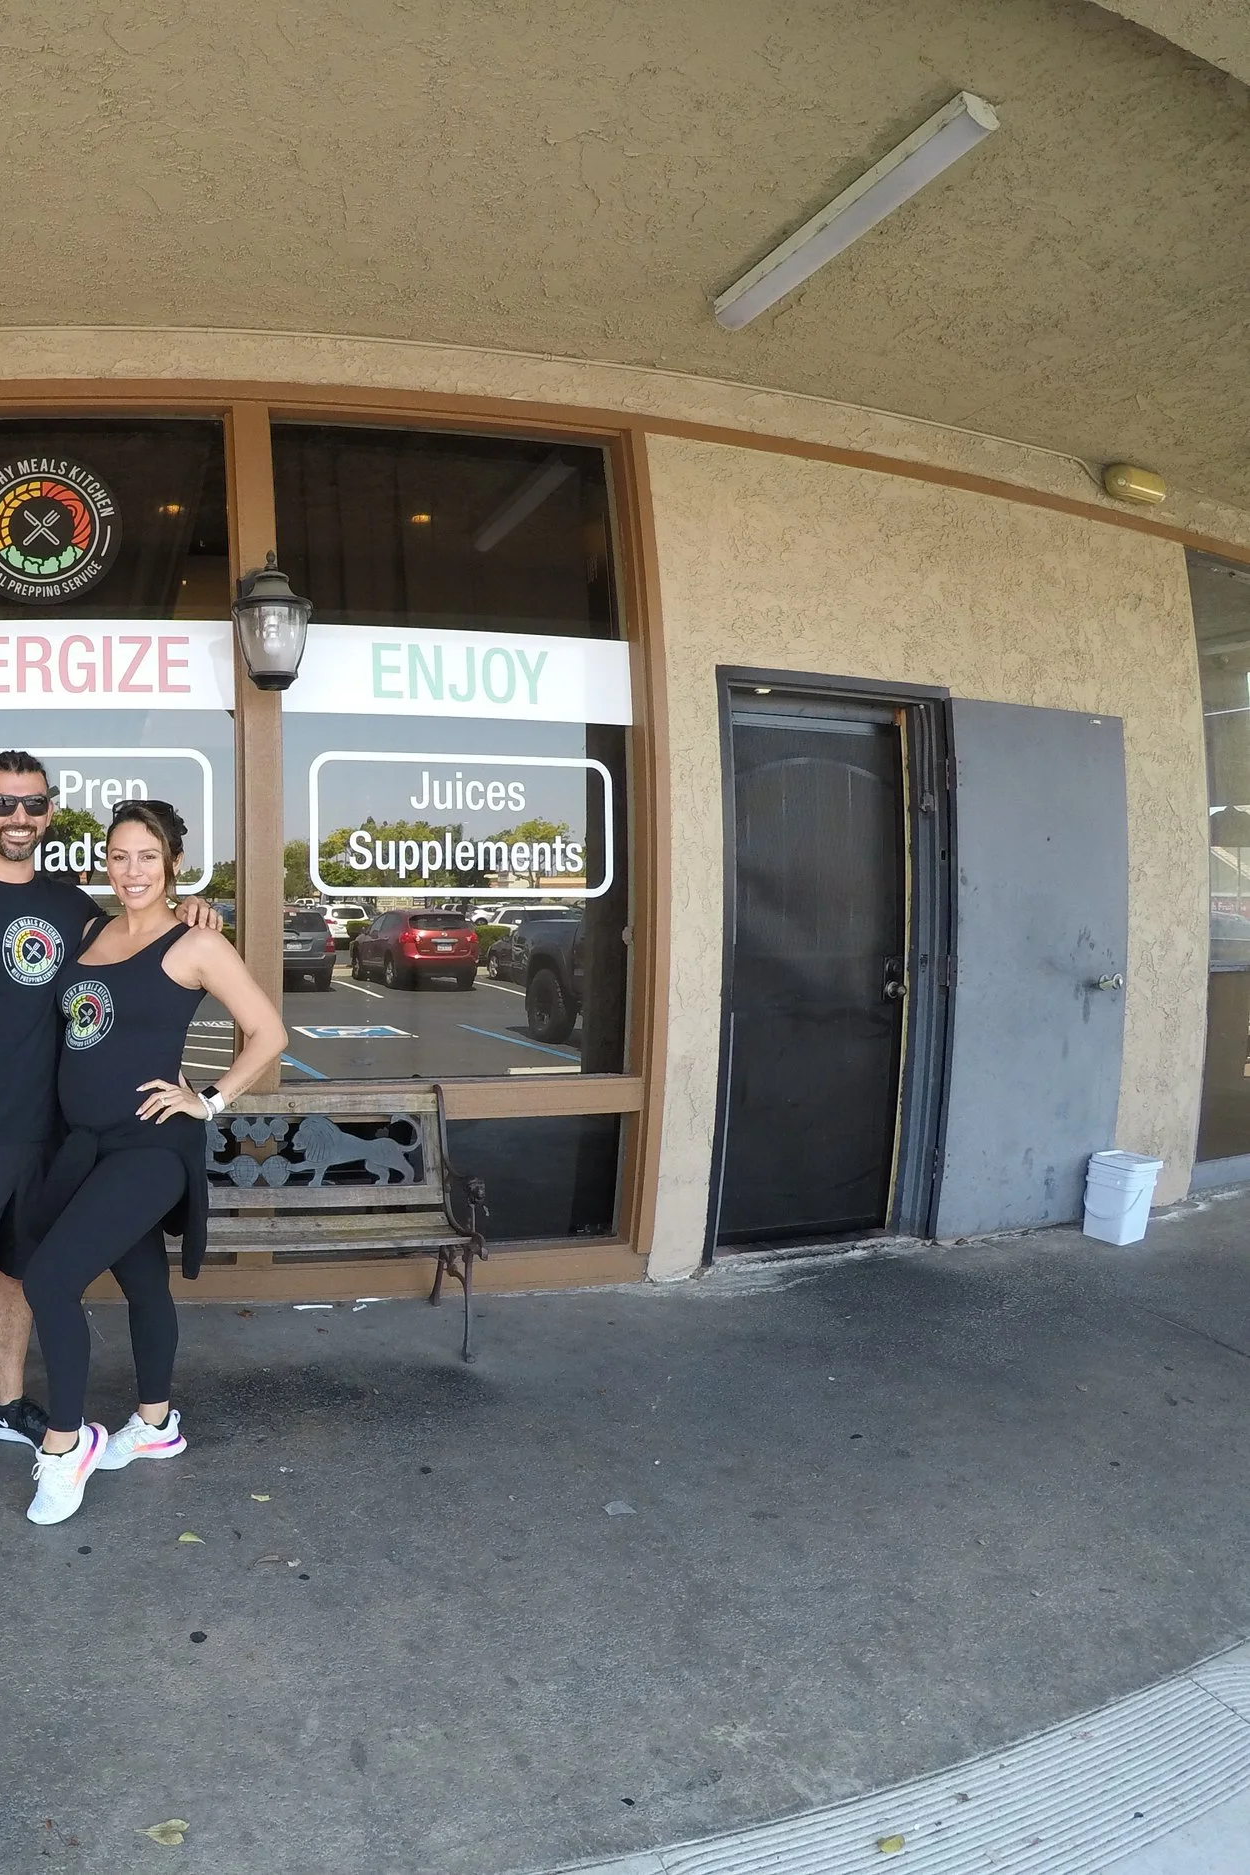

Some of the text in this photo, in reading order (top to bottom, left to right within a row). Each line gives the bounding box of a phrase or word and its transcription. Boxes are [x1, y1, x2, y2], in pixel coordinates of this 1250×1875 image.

[18, 458, 68, 475] MEALS
[68, 466, 115, 518] KITCHEN
[7, 580, 61, 598] PREPPING
[63, 561, 102, 594] SERVICE
[371, 642, 549, 705] ENJOY
[410, 770, 526, 812] Juices
[350, 831, 584, 879] Supplements
[6, 918, 61, 948] HEALTHY MEALS KITCHEN
[78, 983, 98, 992] MEALS
[97, 986, 111, 1013] KITCHEN
